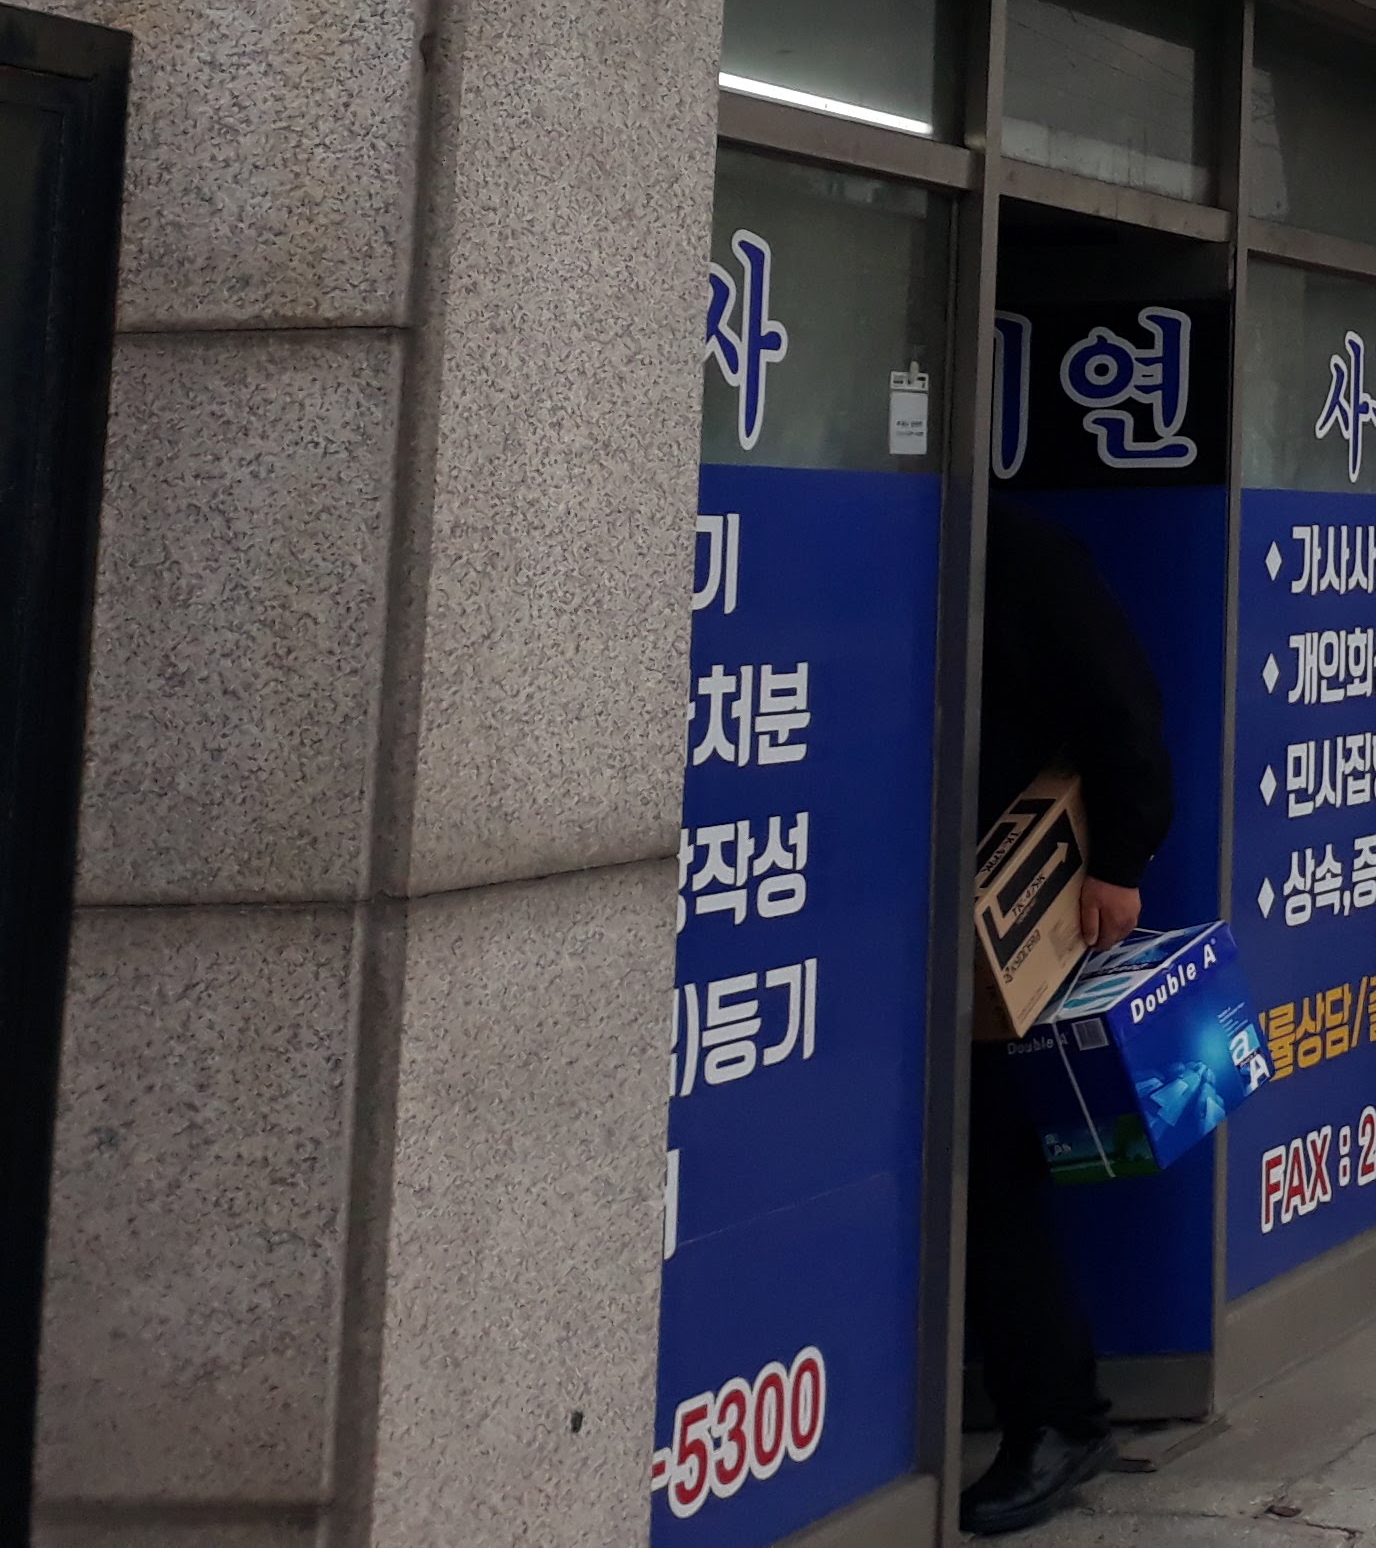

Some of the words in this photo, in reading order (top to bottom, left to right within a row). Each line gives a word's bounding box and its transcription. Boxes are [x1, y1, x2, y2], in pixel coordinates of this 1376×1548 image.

[687, 662, 812, 768] 처분
[669, 957, 818, 1097] )등기
[1129, 959, 1197, 1025] Double
[1202, 943, 1218, 970] A
[1006, 1035, 1055, 1056] Double
[1260, 1124, 1332, 1234] FAX
